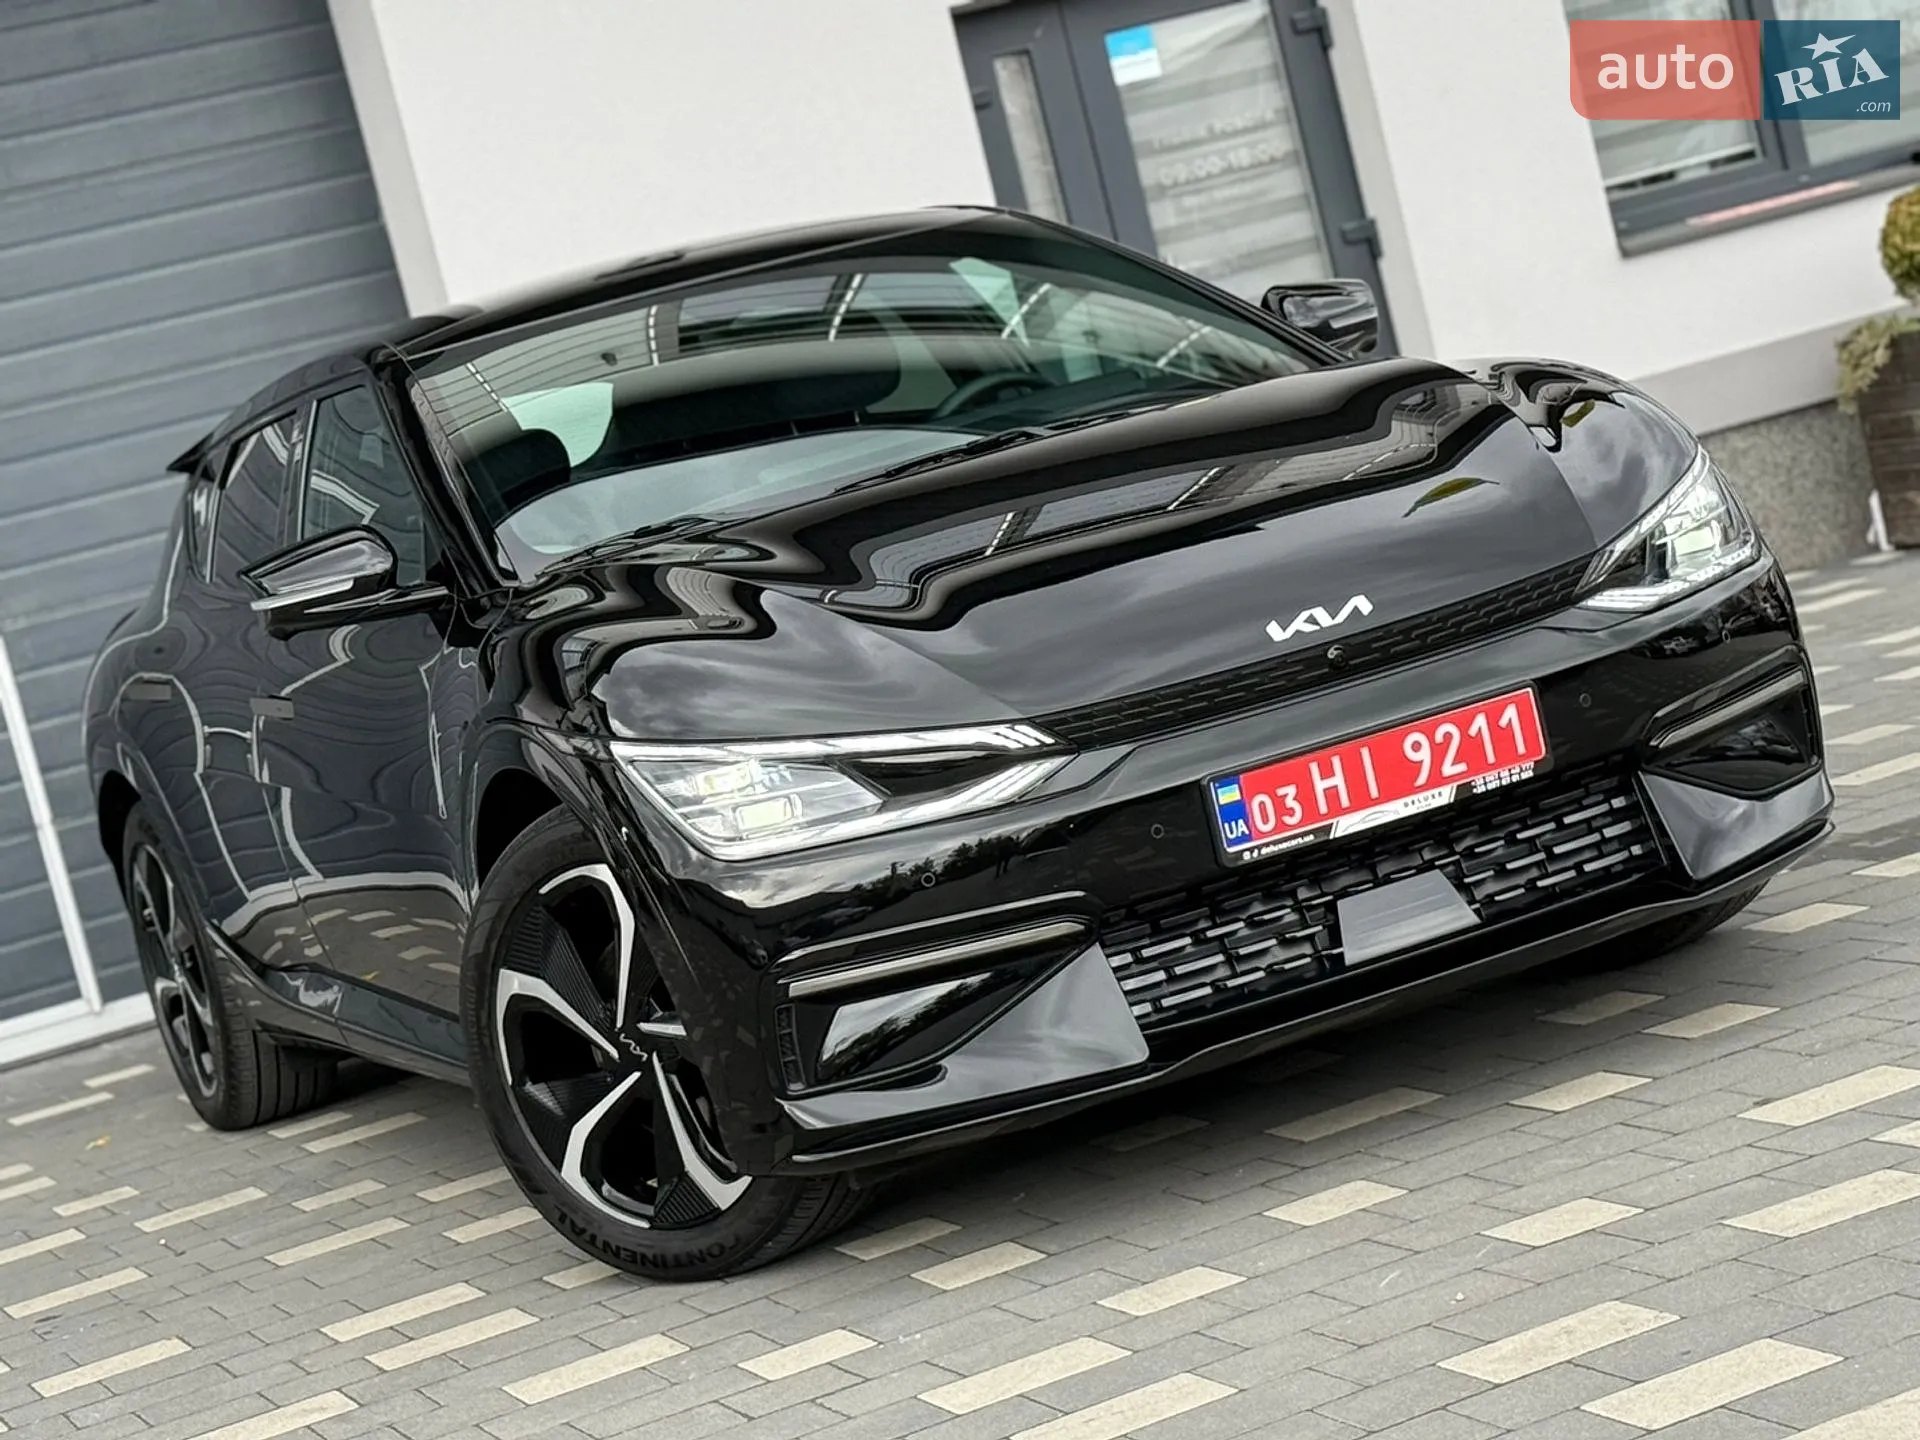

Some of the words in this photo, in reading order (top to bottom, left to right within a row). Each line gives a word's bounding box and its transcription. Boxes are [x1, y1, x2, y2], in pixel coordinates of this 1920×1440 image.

[1265, 593, 1375, 643] KIA
[1251, 783, 1303, 834] 03
[1308, 746, 1380, 816] HI
[1402, 702, 1527, 788] 9211
[1402, 790, 1444, 809] DELUXE
[1224, 819, 1250, 839] UA
